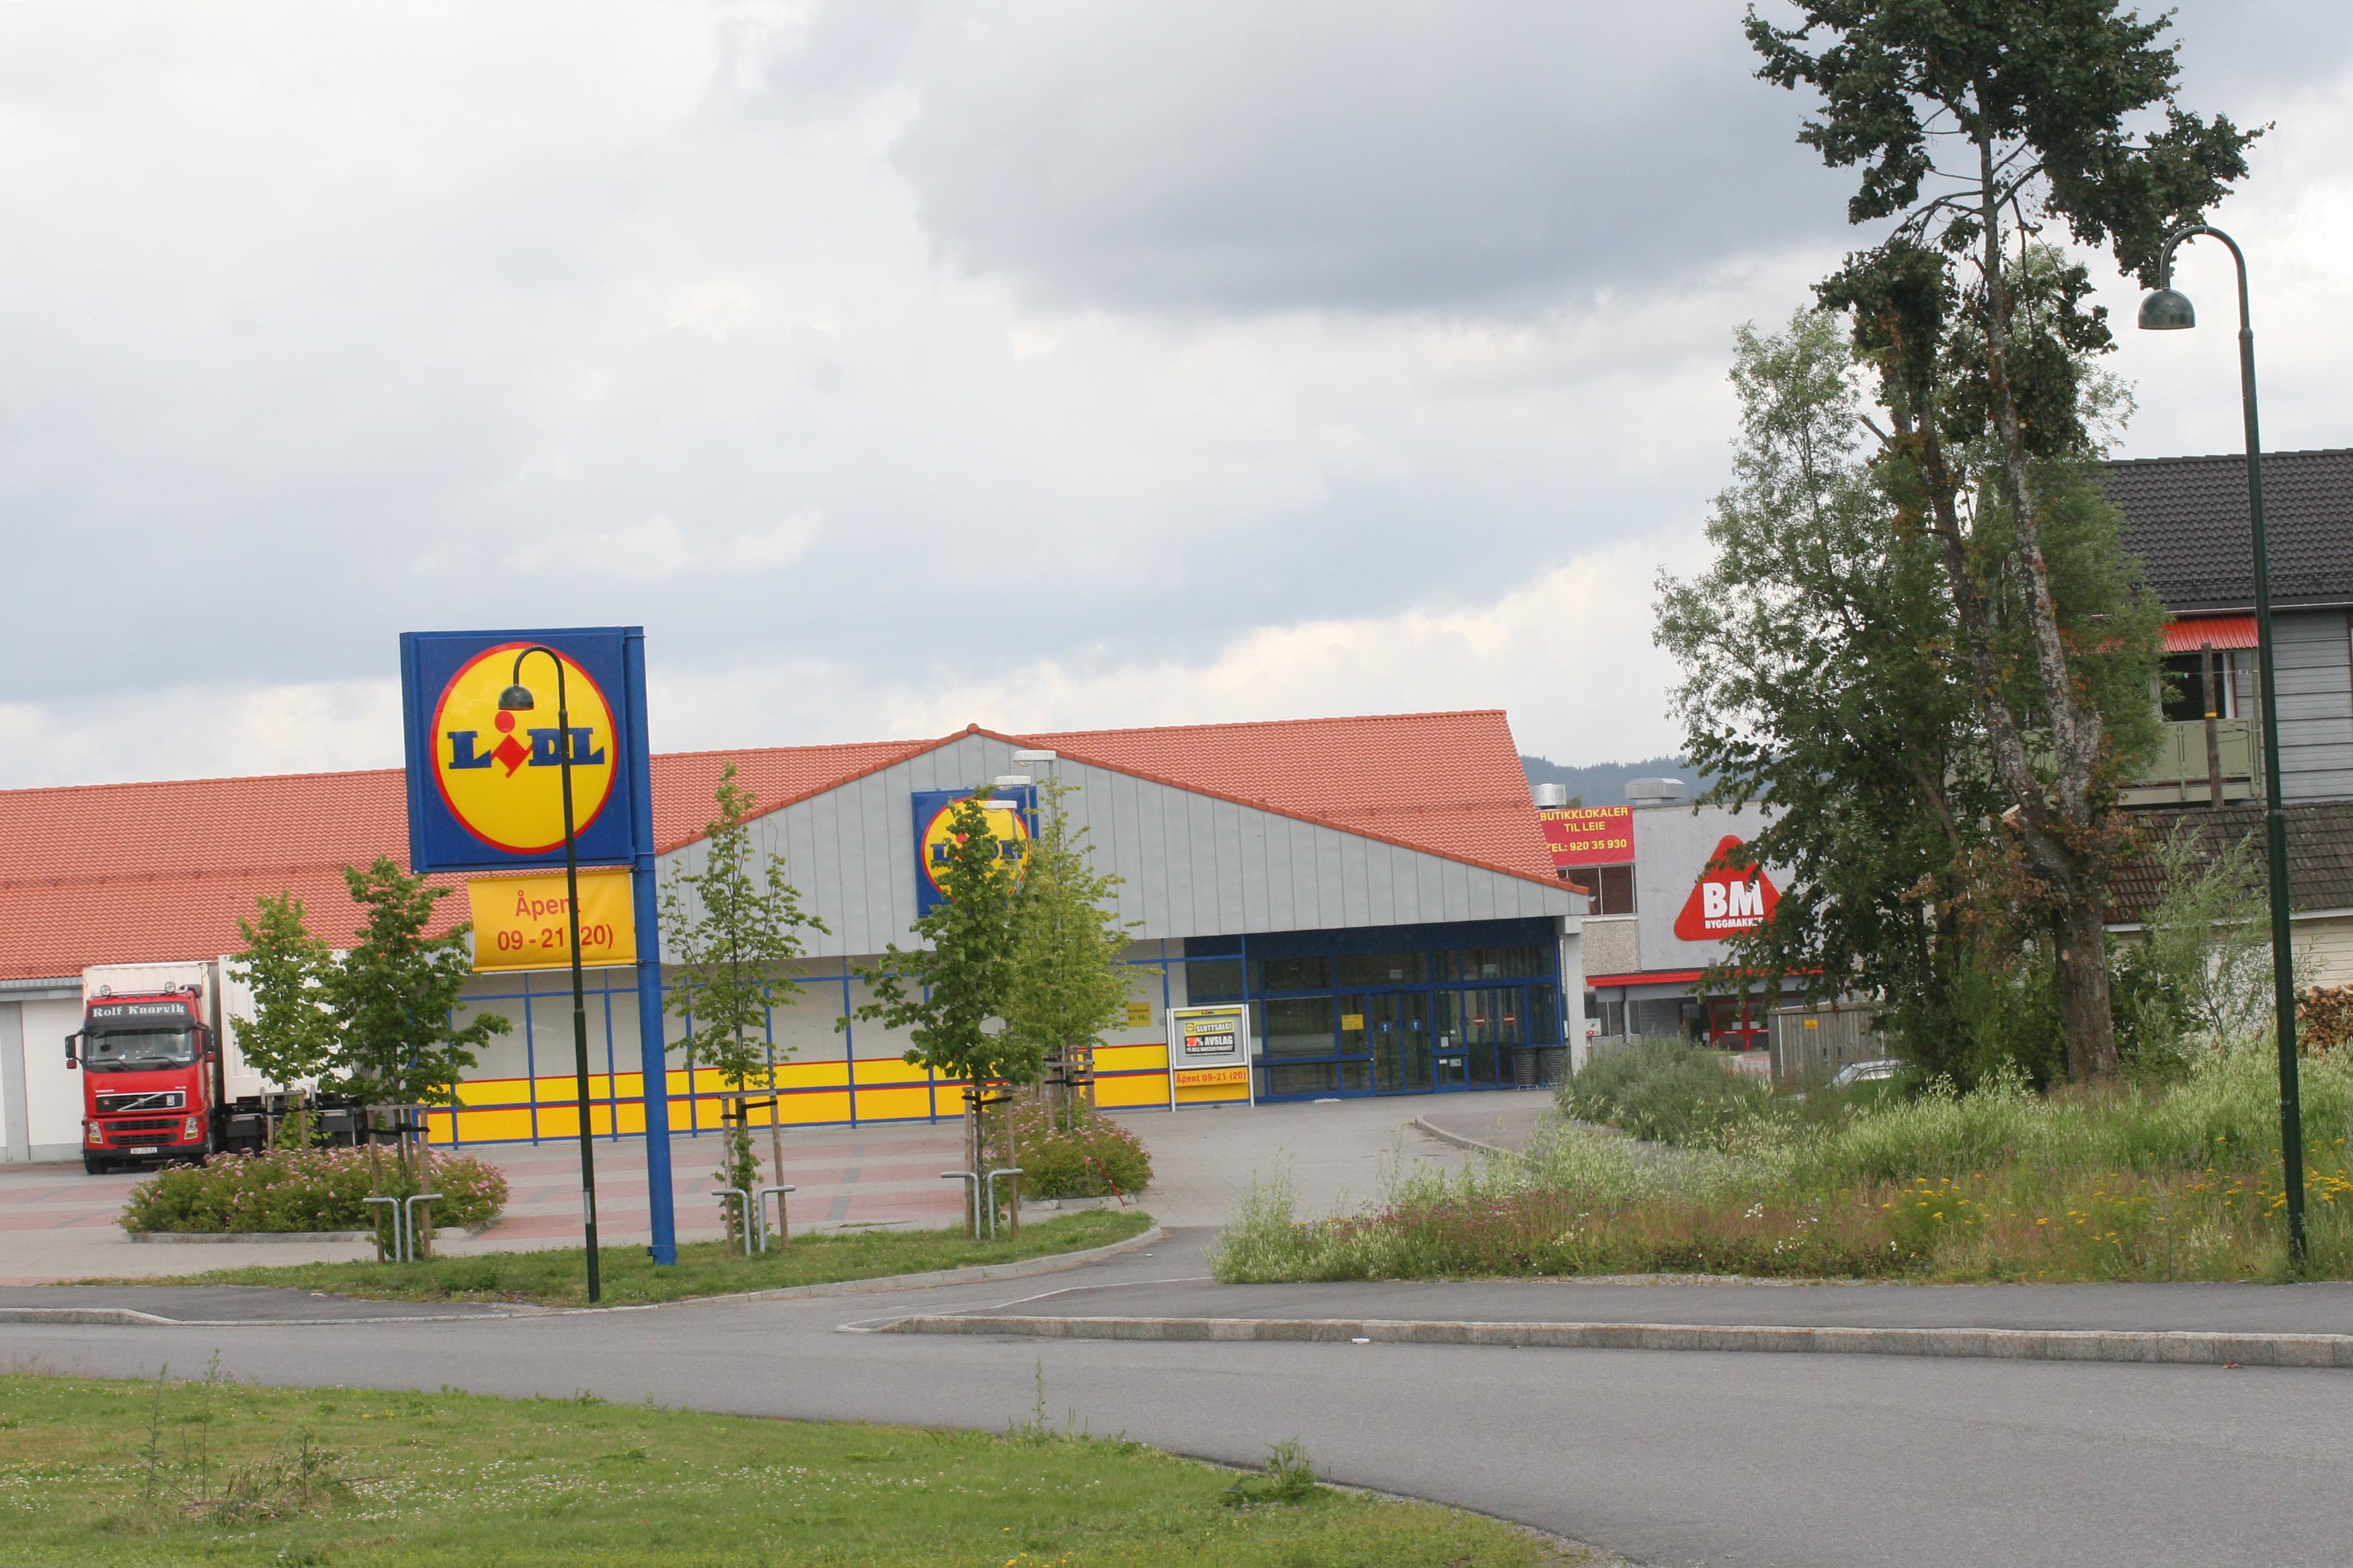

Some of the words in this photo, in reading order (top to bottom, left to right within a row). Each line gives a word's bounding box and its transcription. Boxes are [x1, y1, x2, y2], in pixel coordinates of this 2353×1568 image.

[1540, 807, 1628, 821] BUTIKKLOKALER
[1564, 823, 1581, 833] TIL
[1583, 821, 1605, 831] LEIE
[1570, 841, 1589, 852] 920
[1591, 840, 1605, 850] 35
[1607, 839, 1627, 849] 930
[1703, 879, 1764, 918] BM
[516, 890, 581, 921] Åpen
[497, 930, 523, 951] 09
[541, 927, 564, 948] 21
[93, 1007, 122, 1018] Rolf
[128, 1004, 185, 1015] Knarvik
[1196, 1023, 1232, 1032] SLUTTSALG!
[1204, 1035, 1233, 1046] AVSLAG
[1176, 1073, 1200, 1084] Åpent
[1202, 1073, 1226, 1081] 09-21
[1230, 1071, 1246, 1081] (20)
